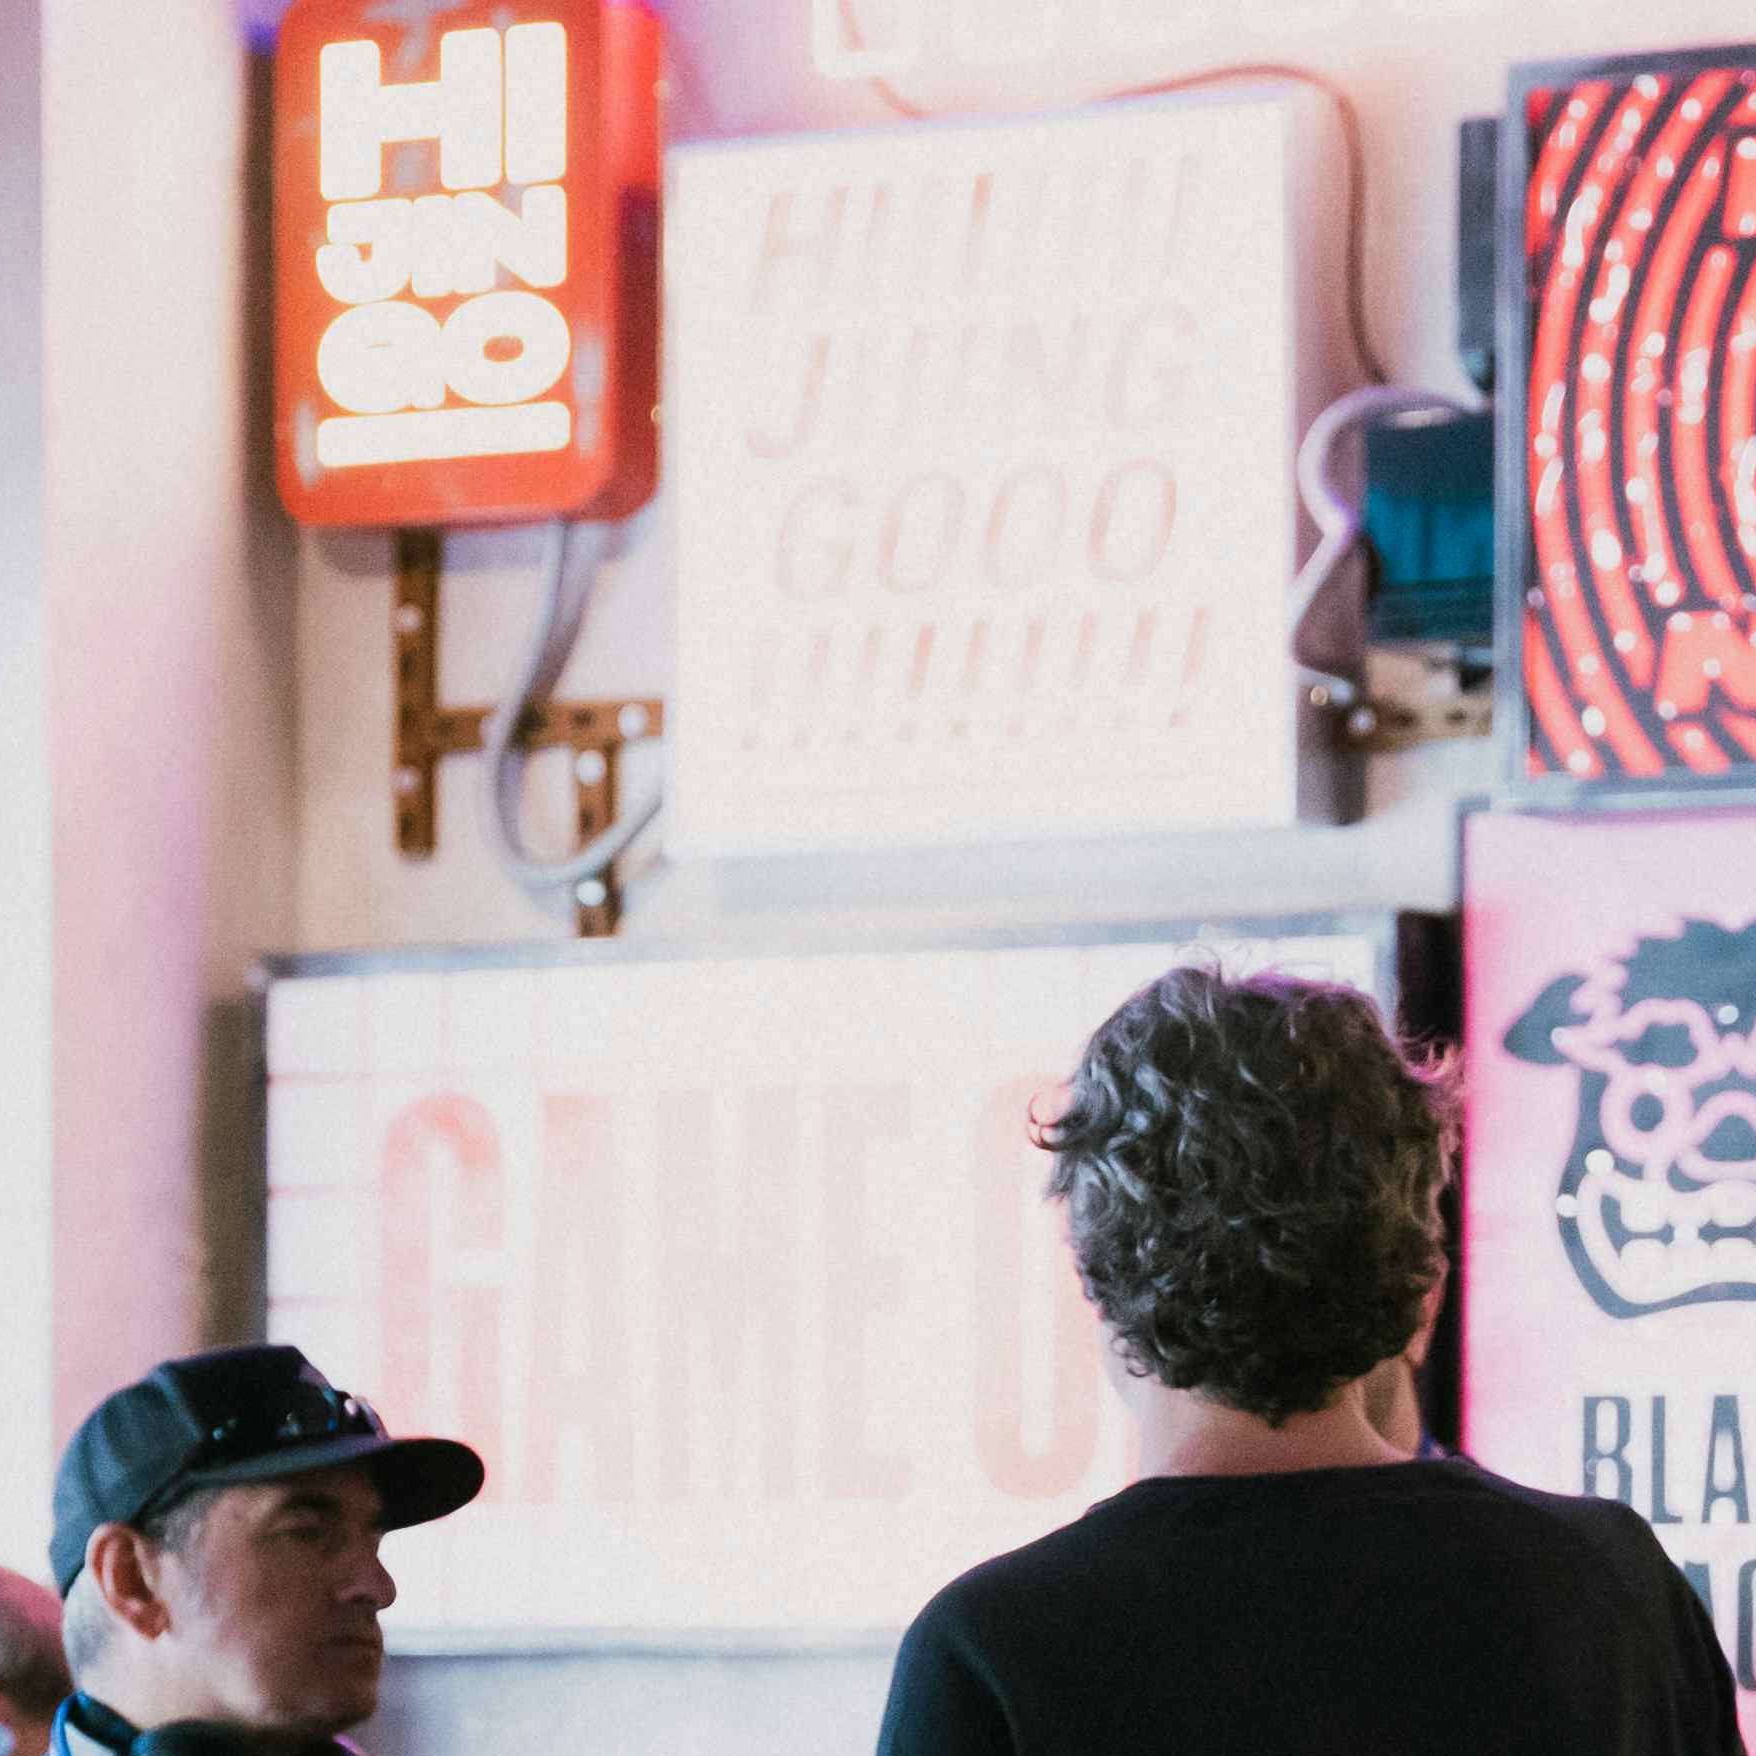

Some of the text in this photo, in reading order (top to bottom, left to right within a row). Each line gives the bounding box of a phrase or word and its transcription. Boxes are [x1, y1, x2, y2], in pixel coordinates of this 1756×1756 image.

[319, 21, 568, 201] HI
[315, 185, 568, 304] JIN
[316, 290, 572, 414] GO
[771, 453, 1182, 601] GOOO
[379, 1072, 1139, 1506] GAME O
